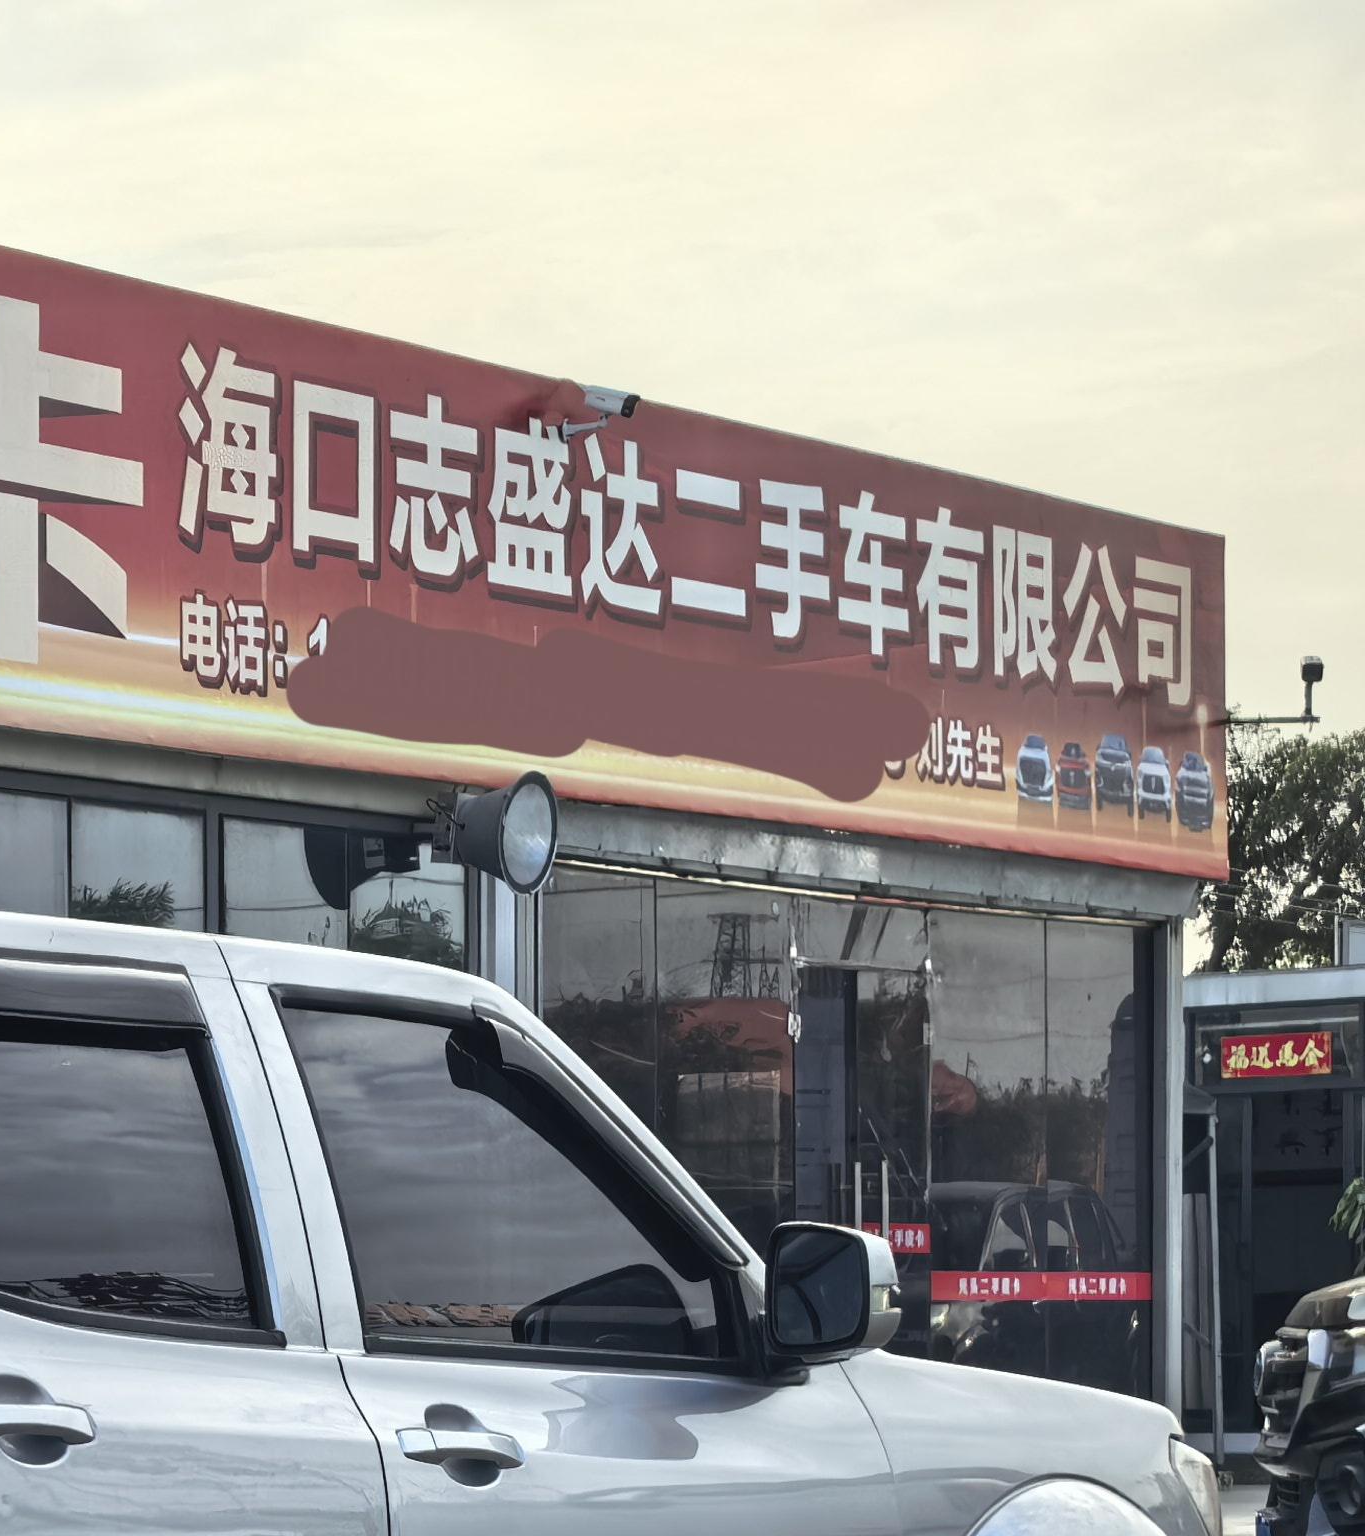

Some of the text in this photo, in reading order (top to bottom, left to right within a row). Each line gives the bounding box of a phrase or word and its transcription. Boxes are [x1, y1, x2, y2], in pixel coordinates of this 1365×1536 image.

[177, 341, 1193, 707] 海口志盛达二手车有限公司
